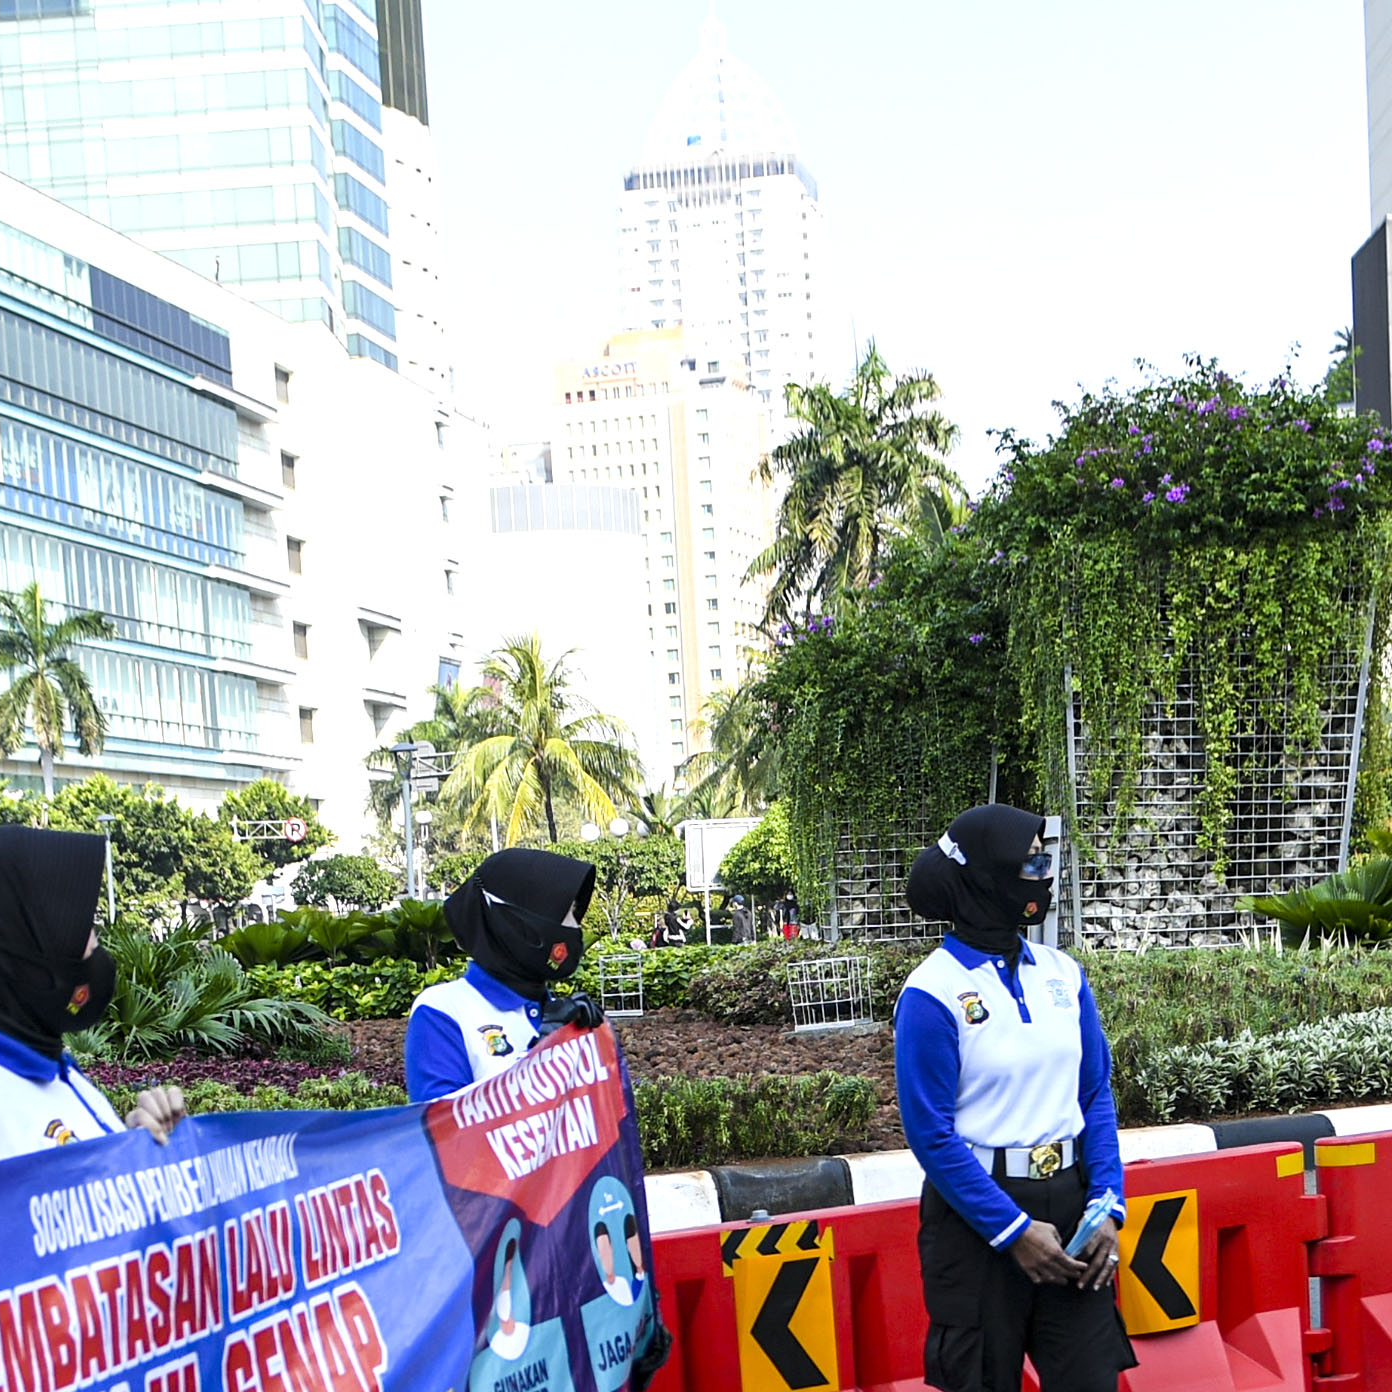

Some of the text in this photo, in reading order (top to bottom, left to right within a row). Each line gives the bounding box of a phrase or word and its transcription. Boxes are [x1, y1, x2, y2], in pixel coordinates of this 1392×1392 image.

[29, 1171, 146, 1257] SOSIALISASI
[225, 1200, 295, 1322] LALU
[295, 1168, 400, 1283] LINTAS
[598, 1332, 632, 1372] JAGA
